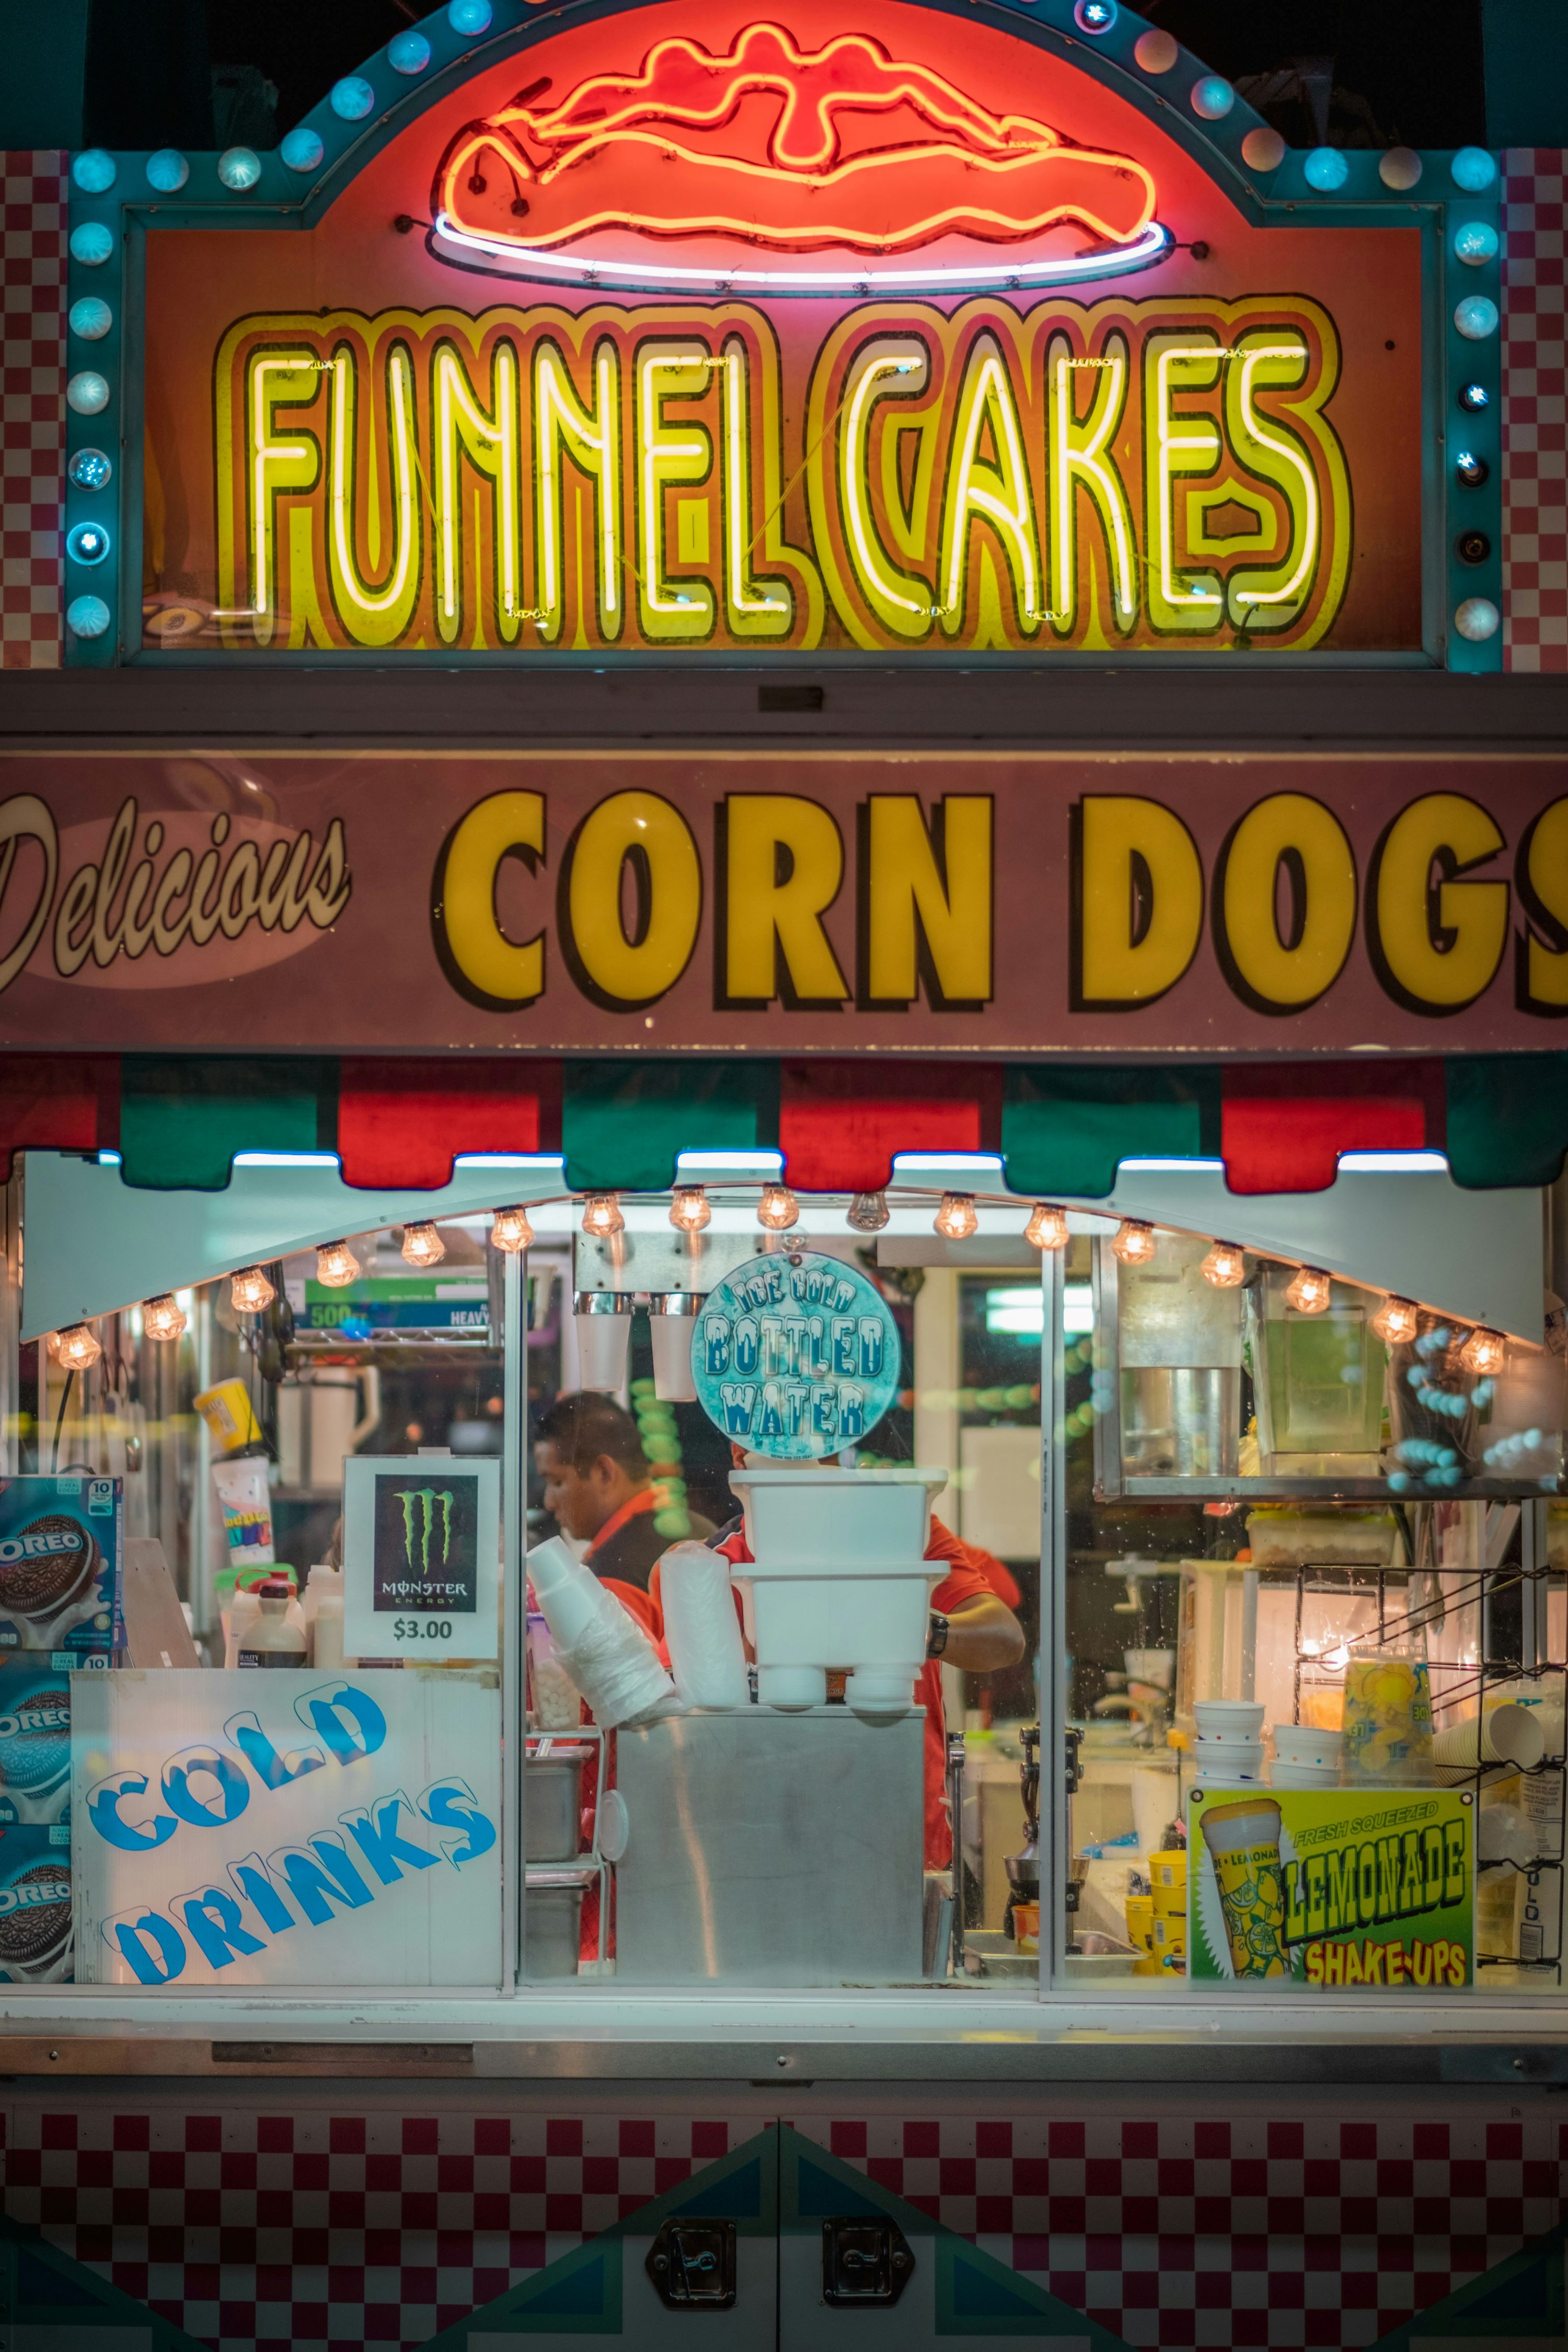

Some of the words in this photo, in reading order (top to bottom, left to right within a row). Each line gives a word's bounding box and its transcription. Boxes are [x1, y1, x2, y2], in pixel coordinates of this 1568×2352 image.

[244, 331, 795, 647] FUNNEL
[832, 323, 1321, 646] CAKES
[0, 792, 352, 994] Delicious
[430, 788, 995, 1013] CORN
[732, 1270, 782, 1312] ICE
[790, 1268, 856, 1312] COLD
[451, 1311, 489, 1325] HEAVY
[704, 1313, 884, 1377] BOTTLED
[720, 1382, 864, 1436] WATER
[94, 1483, 109, 1493] 10
[0, 1534, 79, 1562] OREO
[382, 1580, 468, 1596] MONSTER
[394, 1618, 452, 1641] $3.00
[89, 1659, 105, 1669] 10
[0, 1710, 71, 1738] OREO
[86, 1681, 387, 1851] COLD
[1294, 1821, 1348, 1848] FRESH
[1351, 1801, 1438, 1835] SQUEEZED
[0, 1883, 71, 1912] OREO
[101, 1777, 496, 1985] DRINKS
[1284, 1818, 1465, 1945] LEMONADE
[1305, 1937, 1467, 1987] SHAKE-UPS
